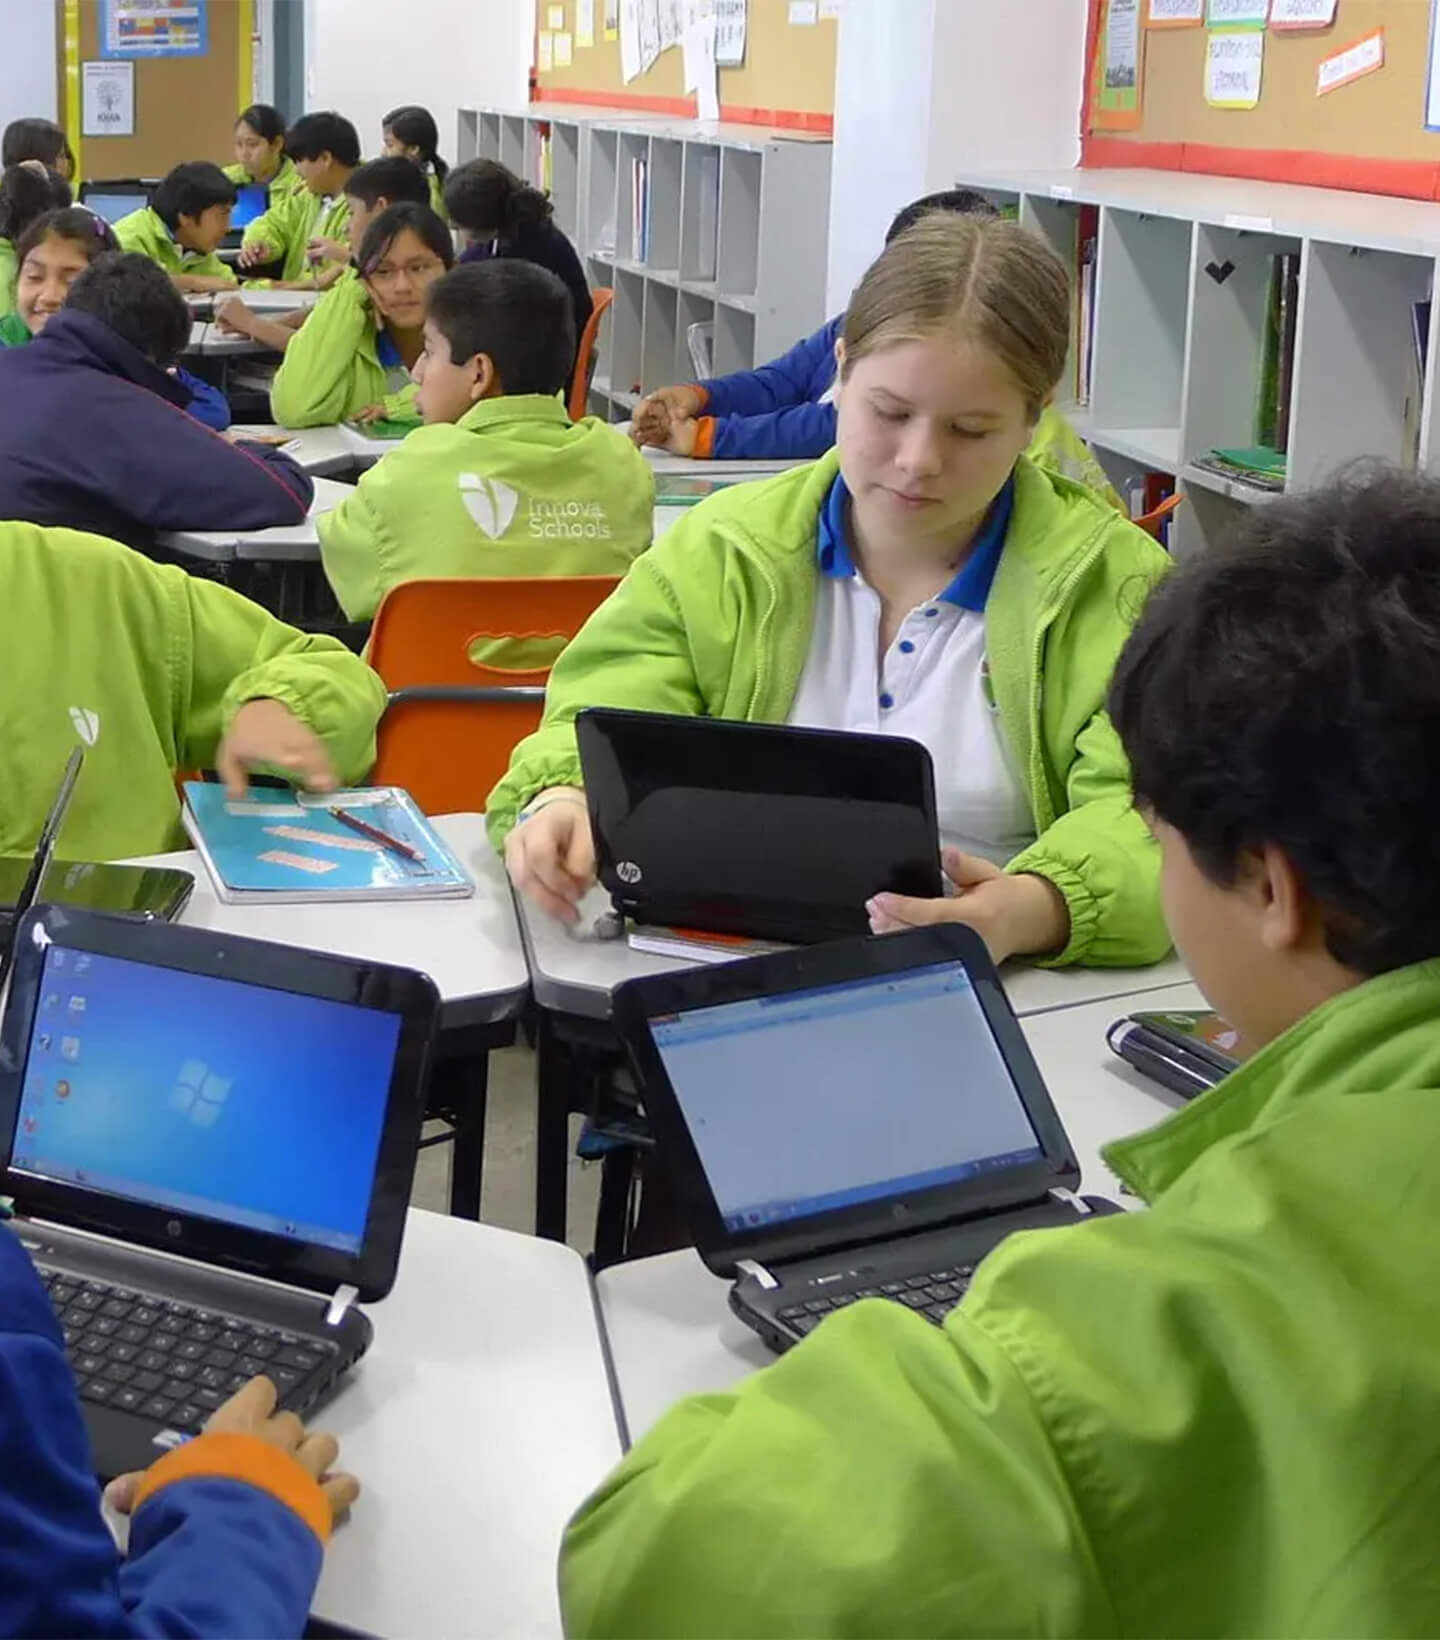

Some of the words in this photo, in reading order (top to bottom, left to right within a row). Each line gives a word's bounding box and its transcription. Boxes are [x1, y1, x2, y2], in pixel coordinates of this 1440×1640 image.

[528, 498, 605, 518] Innova
[528, 518, 611, 538] Schools
[618, 861, 640, 883] hp
